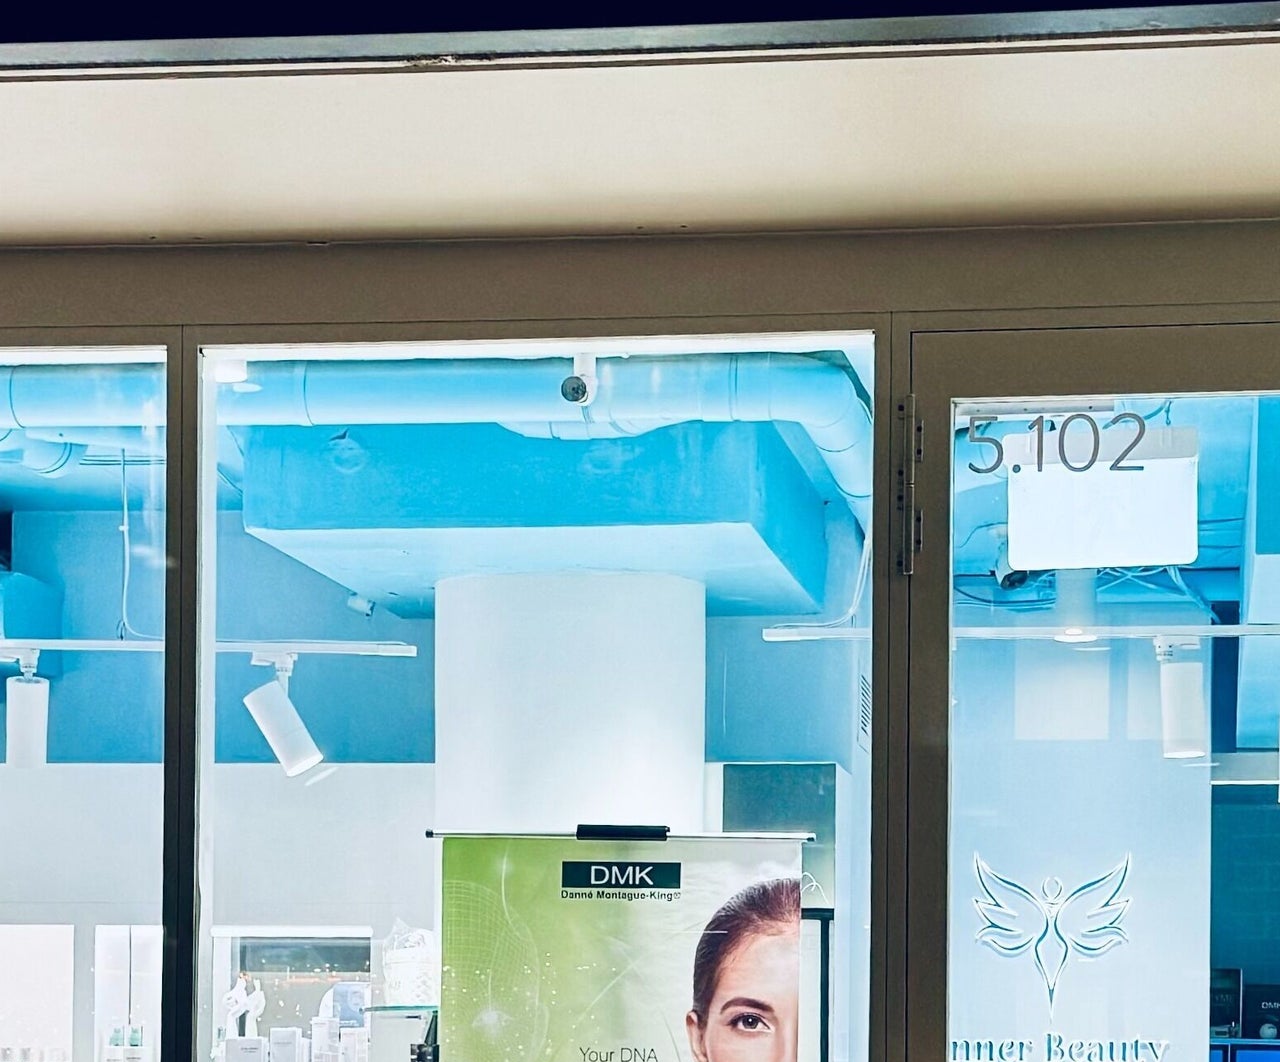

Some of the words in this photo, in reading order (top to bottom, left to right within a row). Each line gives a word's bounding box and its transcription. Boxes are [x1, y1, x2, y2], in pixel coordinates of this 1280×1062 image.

[968, 412, 1146, 474] 5.102
[590, 865, 654, 886] DMK
[579, 1047, 615, 1062] Your
[620, 1047, 659, 1062] DNA
[951, 1039, 1034, 1062] nner
